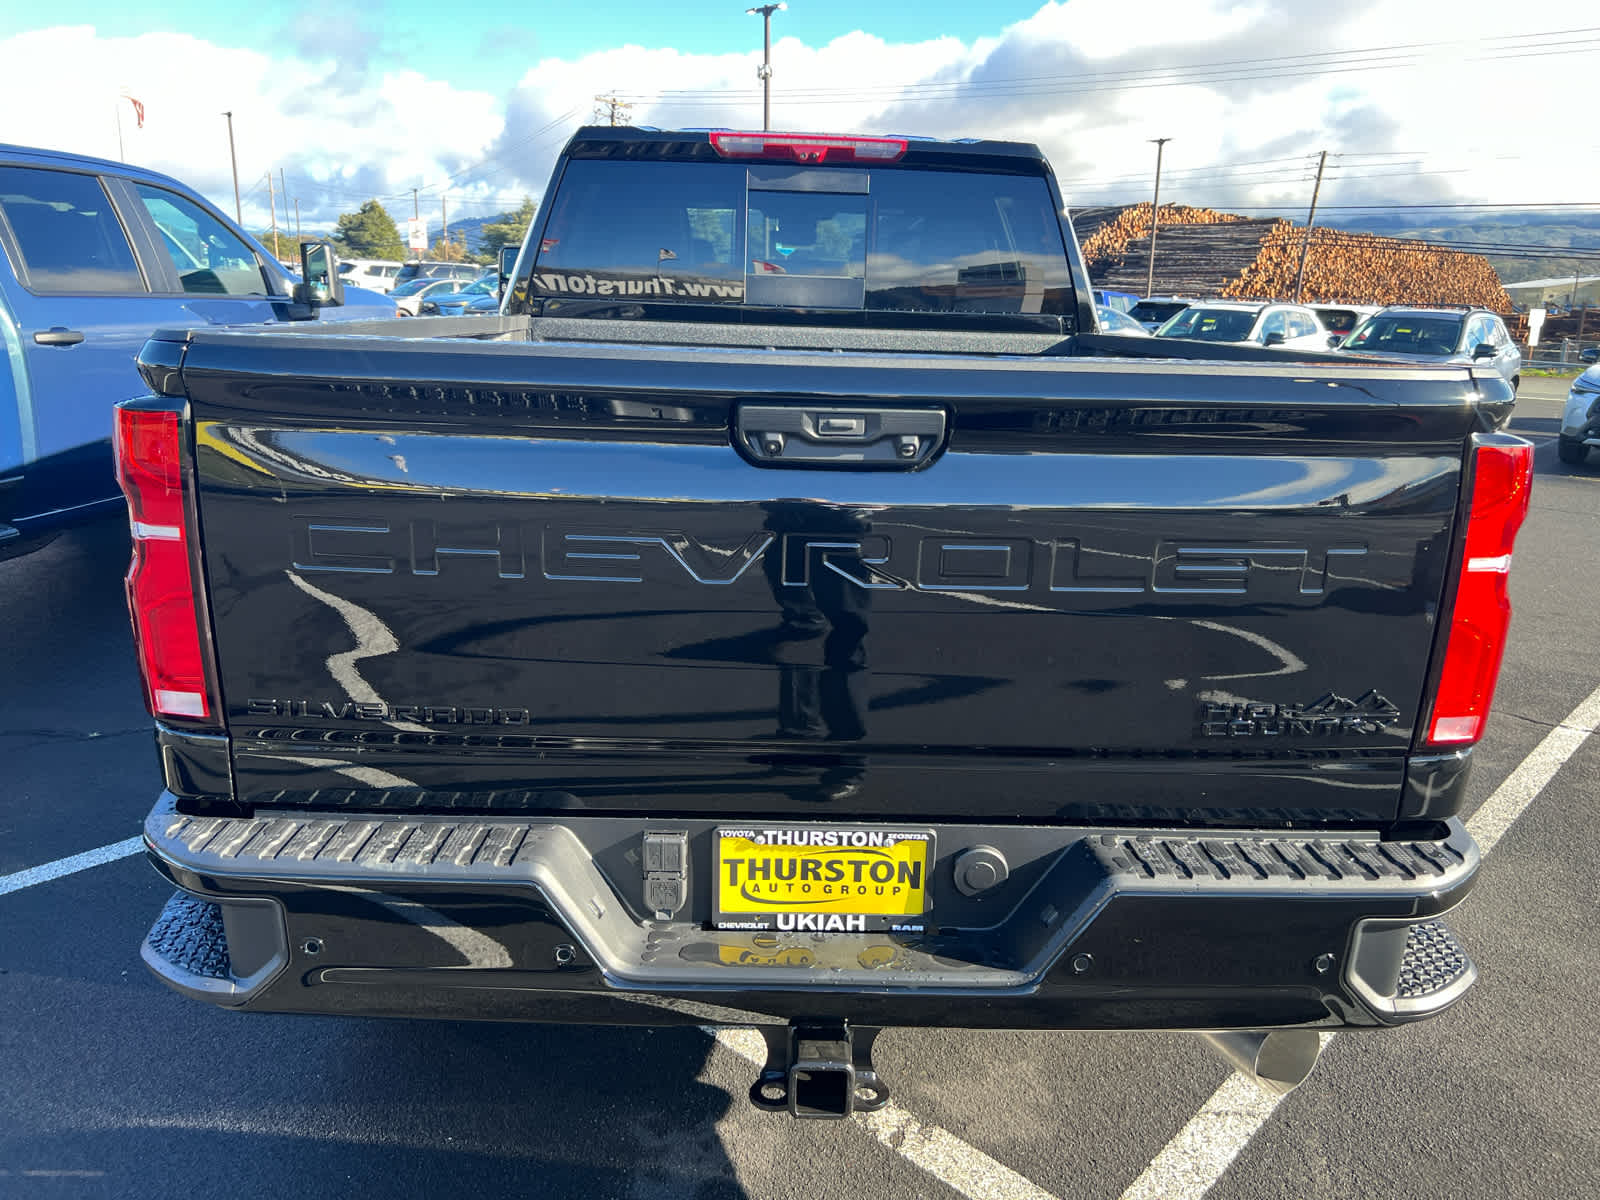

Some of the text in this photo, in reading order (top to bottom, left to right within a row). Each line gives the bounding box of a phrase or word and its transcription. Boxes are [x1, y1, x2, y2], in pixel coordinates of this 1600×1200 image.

[293, 514, 1368, 594] CHEVROLET
[247, 699, 530, 725] SILVERADO
[718, 830, 755, 838] TOYOTA
[763, 830, 884, 847] THURSTON
[887, 833, 930, 841] HONDA
[723, 858, 921, 890] THURSTON
[776, 913, 866, 931] UKIAH
